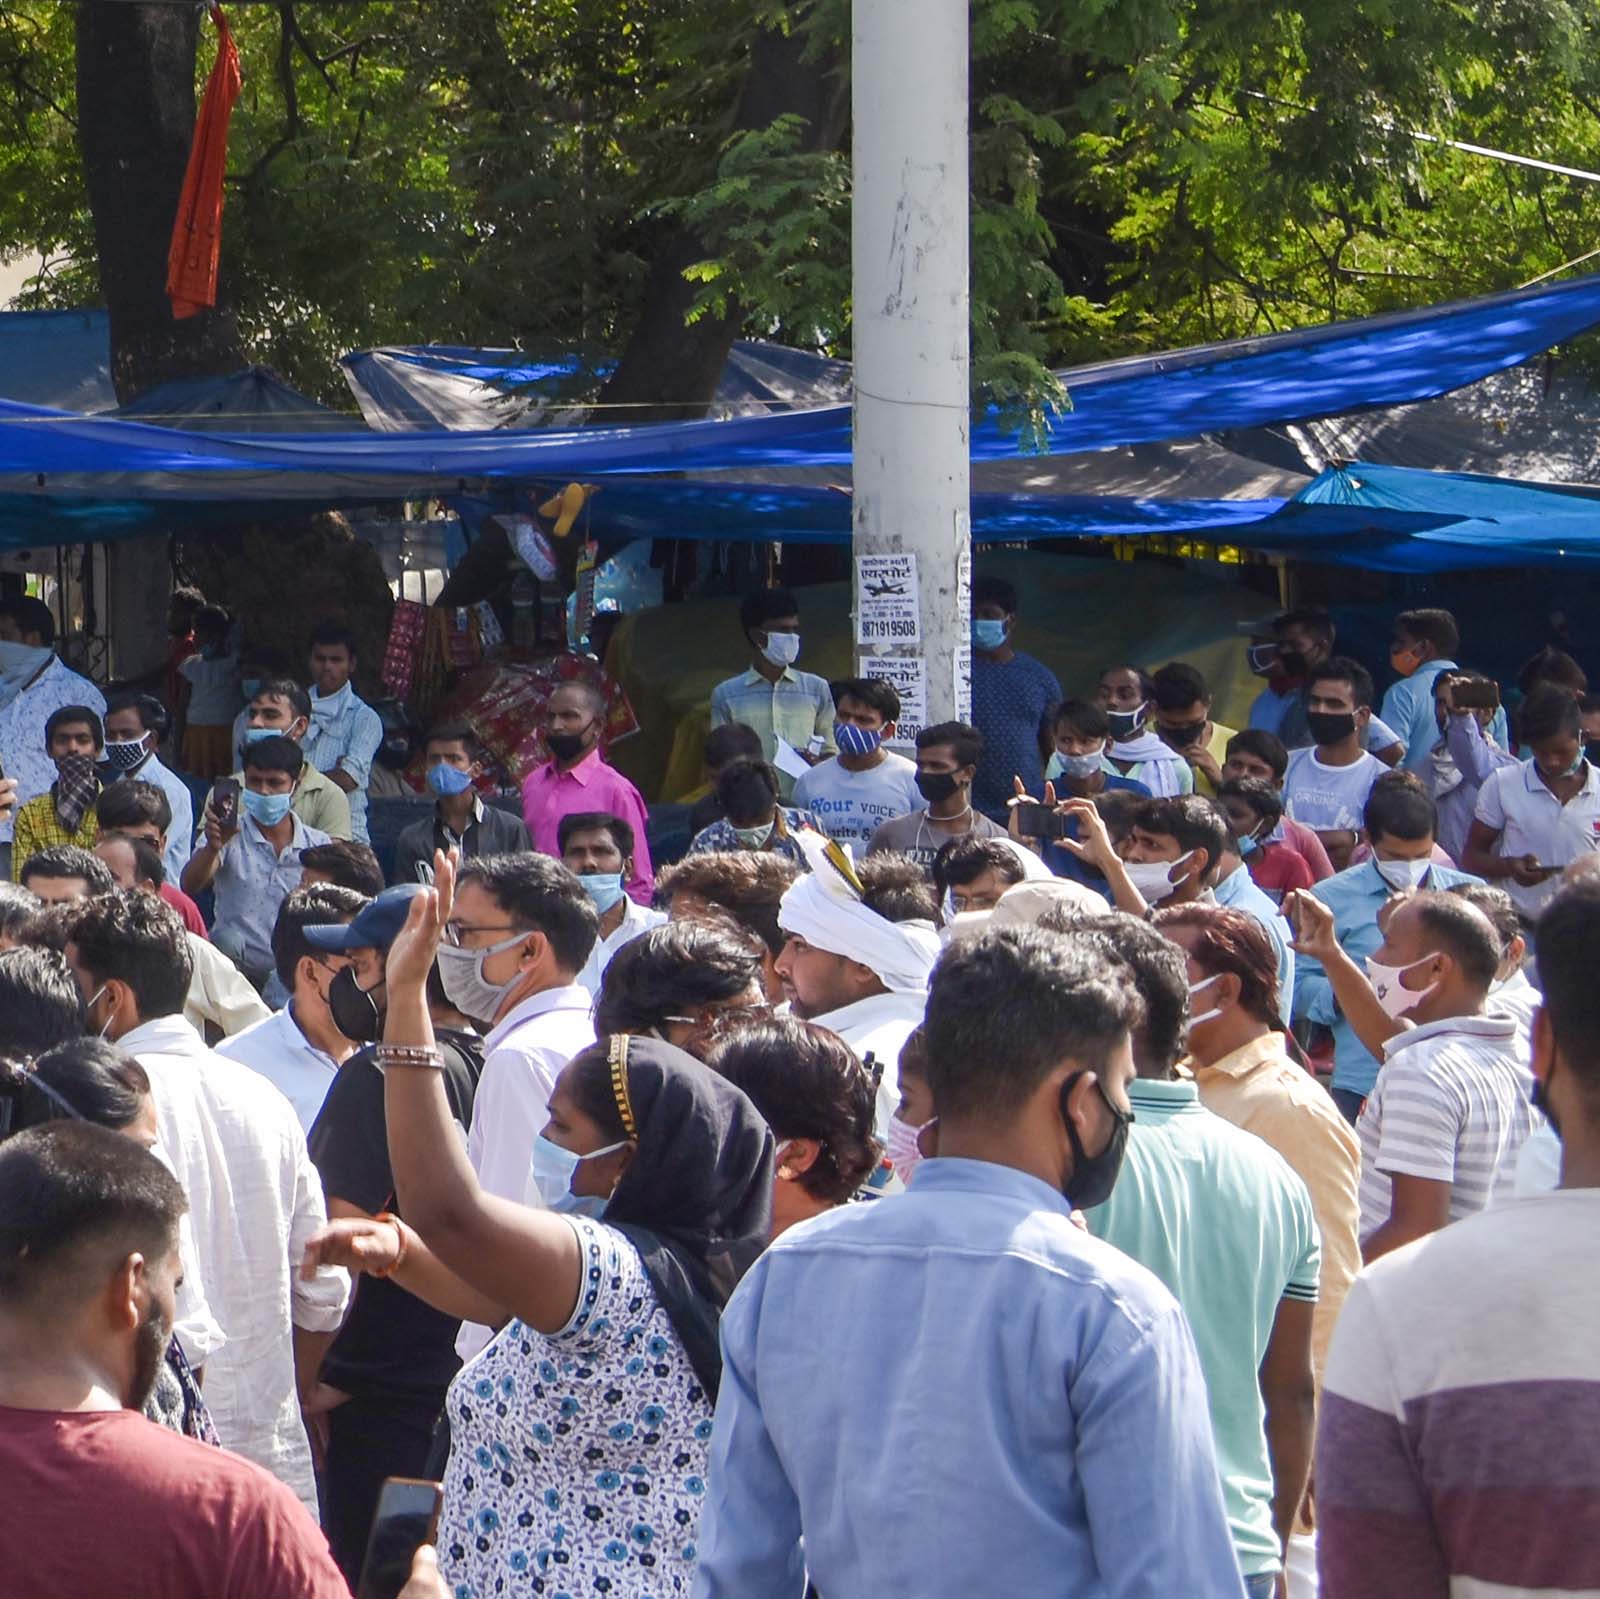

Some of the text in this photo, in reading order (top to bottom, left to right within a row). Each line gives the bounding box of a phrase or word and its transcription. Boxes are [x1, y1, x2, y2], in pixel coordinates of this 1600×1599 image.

[861, 567, 912, 581] एयरपोर्ट
[810, 797, 896, 818] Your VOICE
